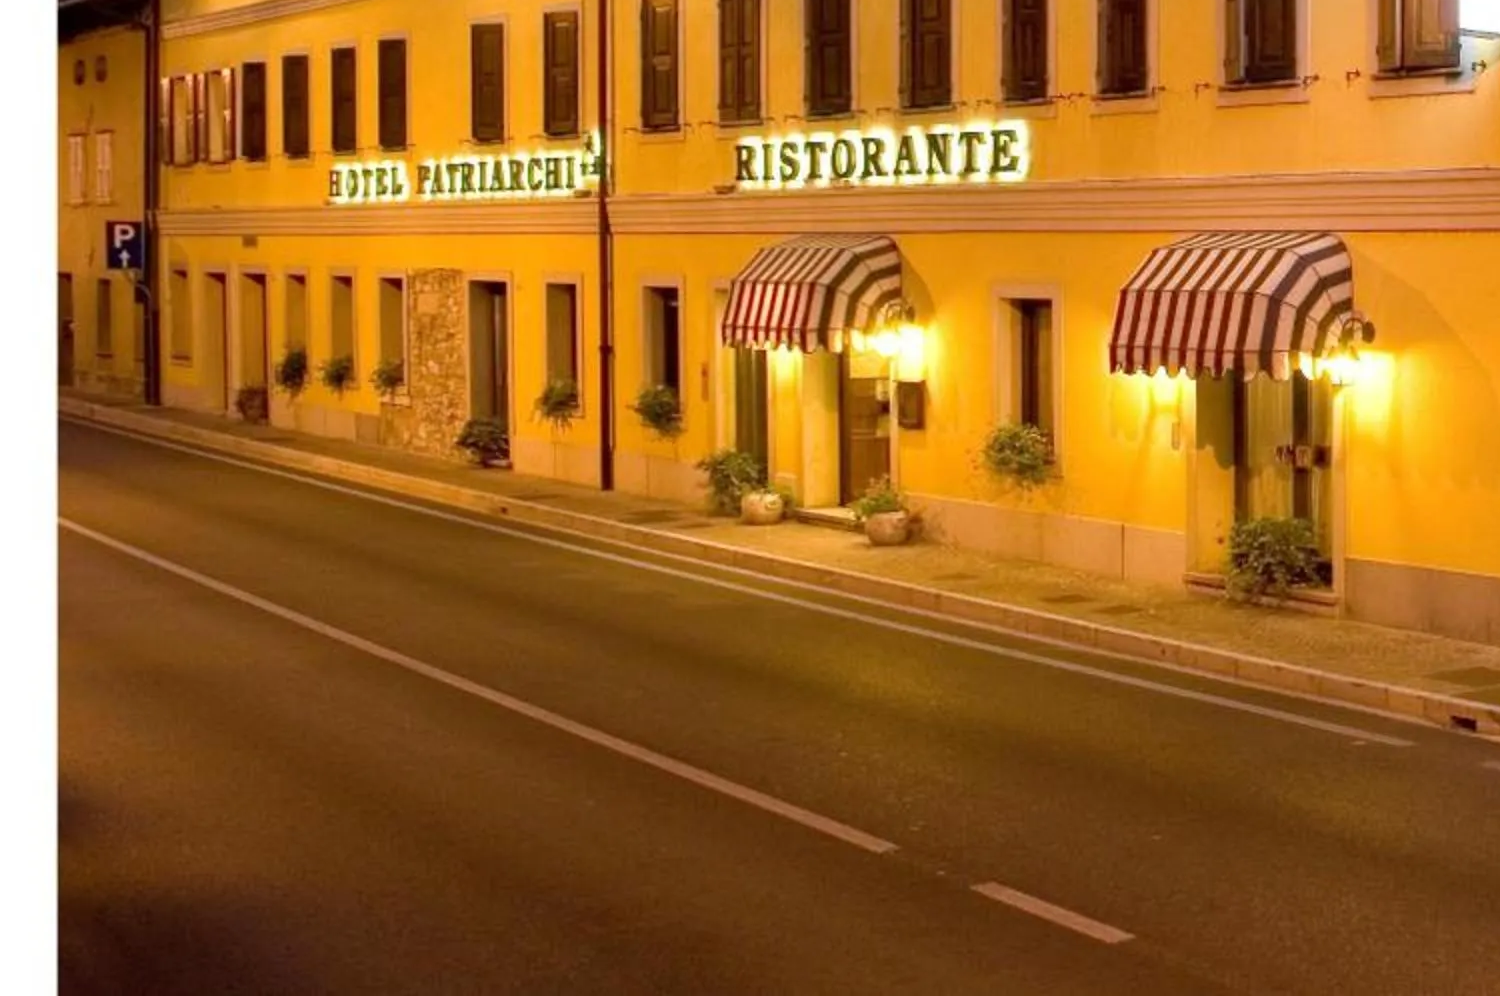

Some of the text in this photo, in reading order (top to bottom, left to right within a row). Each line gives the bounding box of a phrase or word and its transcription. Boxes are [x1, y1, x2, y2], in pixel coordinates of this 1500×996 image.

[735, 129, 1020, 181] RISTORANTE
[329, 156, 576, 198] HOTEL PATRIARCHI
[114, 224, 136, 248] P
